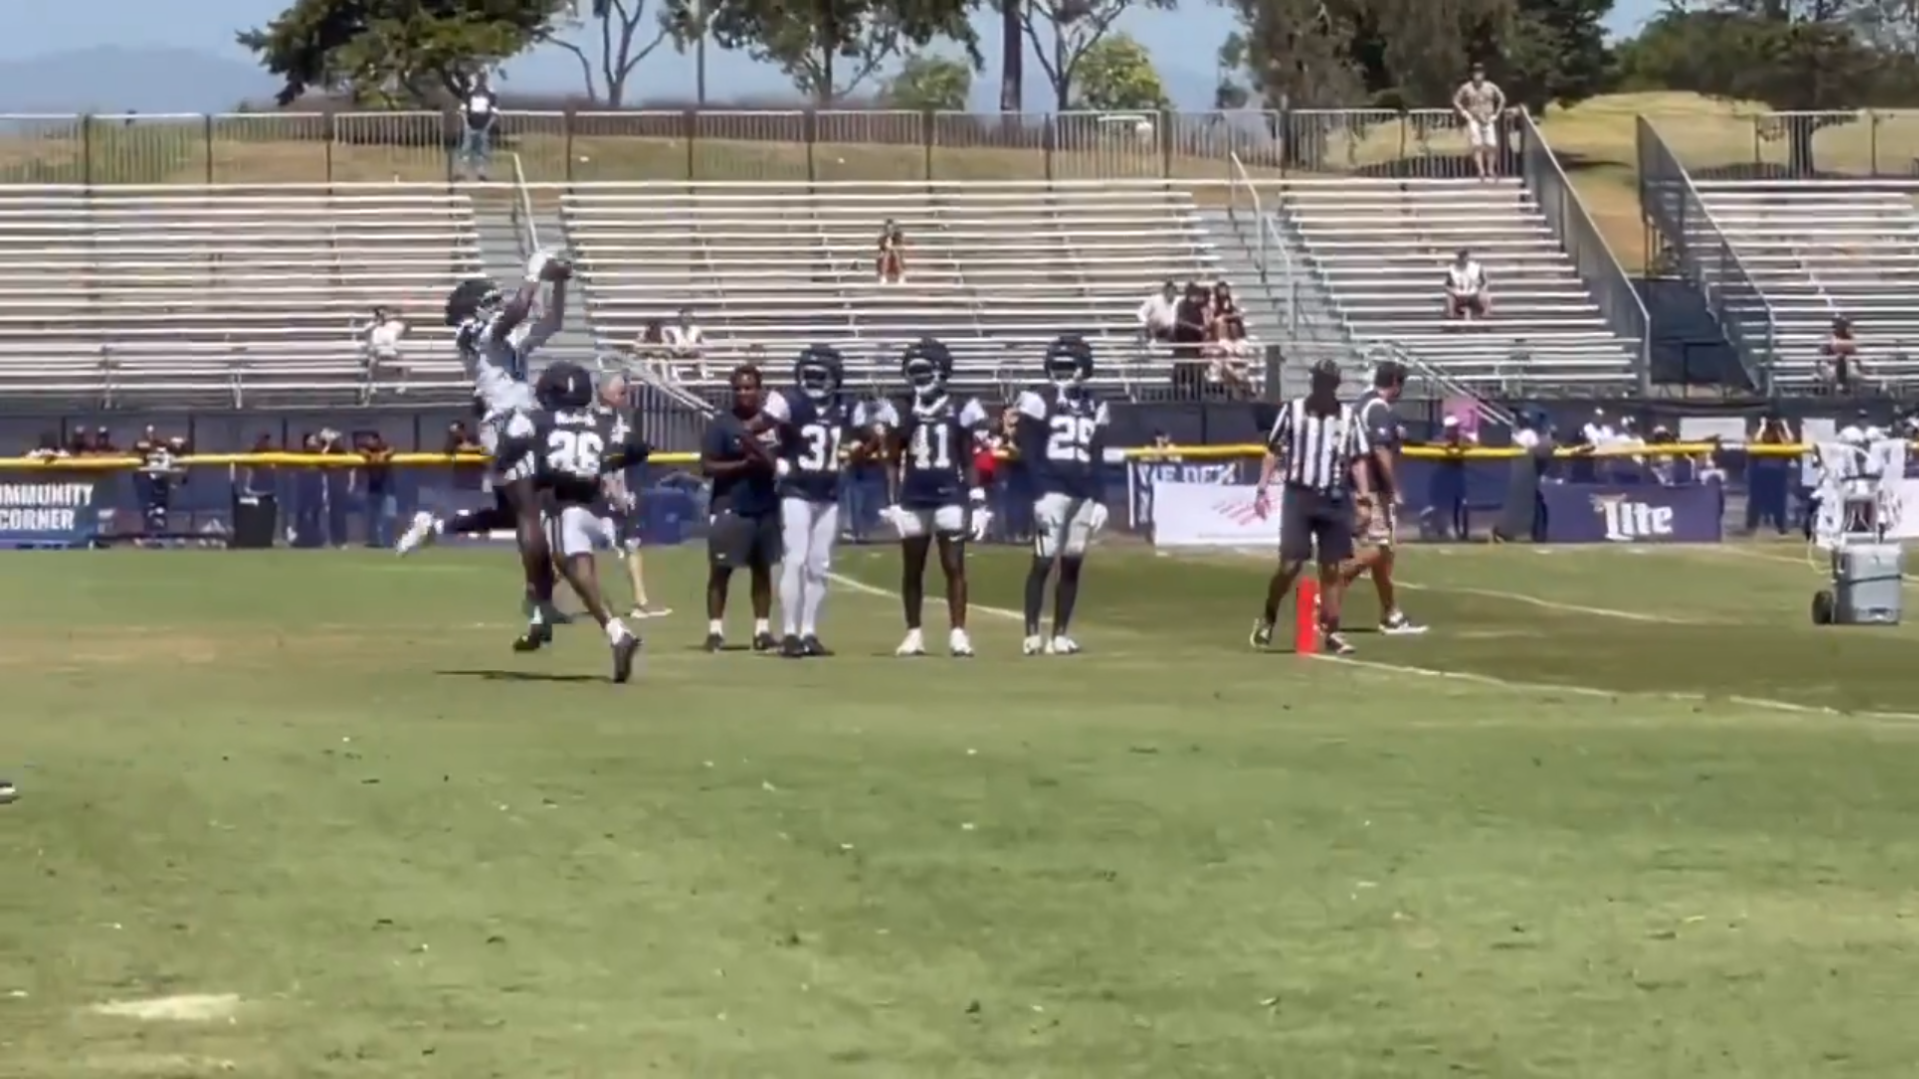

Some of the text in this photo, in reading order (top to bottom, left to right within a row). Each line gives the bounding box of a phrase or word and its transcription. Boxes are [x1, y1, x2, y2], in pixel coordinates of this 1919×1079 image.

[798, 422, 841, 471] 31
[910, 423, 951, 470] 41
[0, 484, 92, 505] MMUNITY
[1594, 495, 1672, 540] Lite
